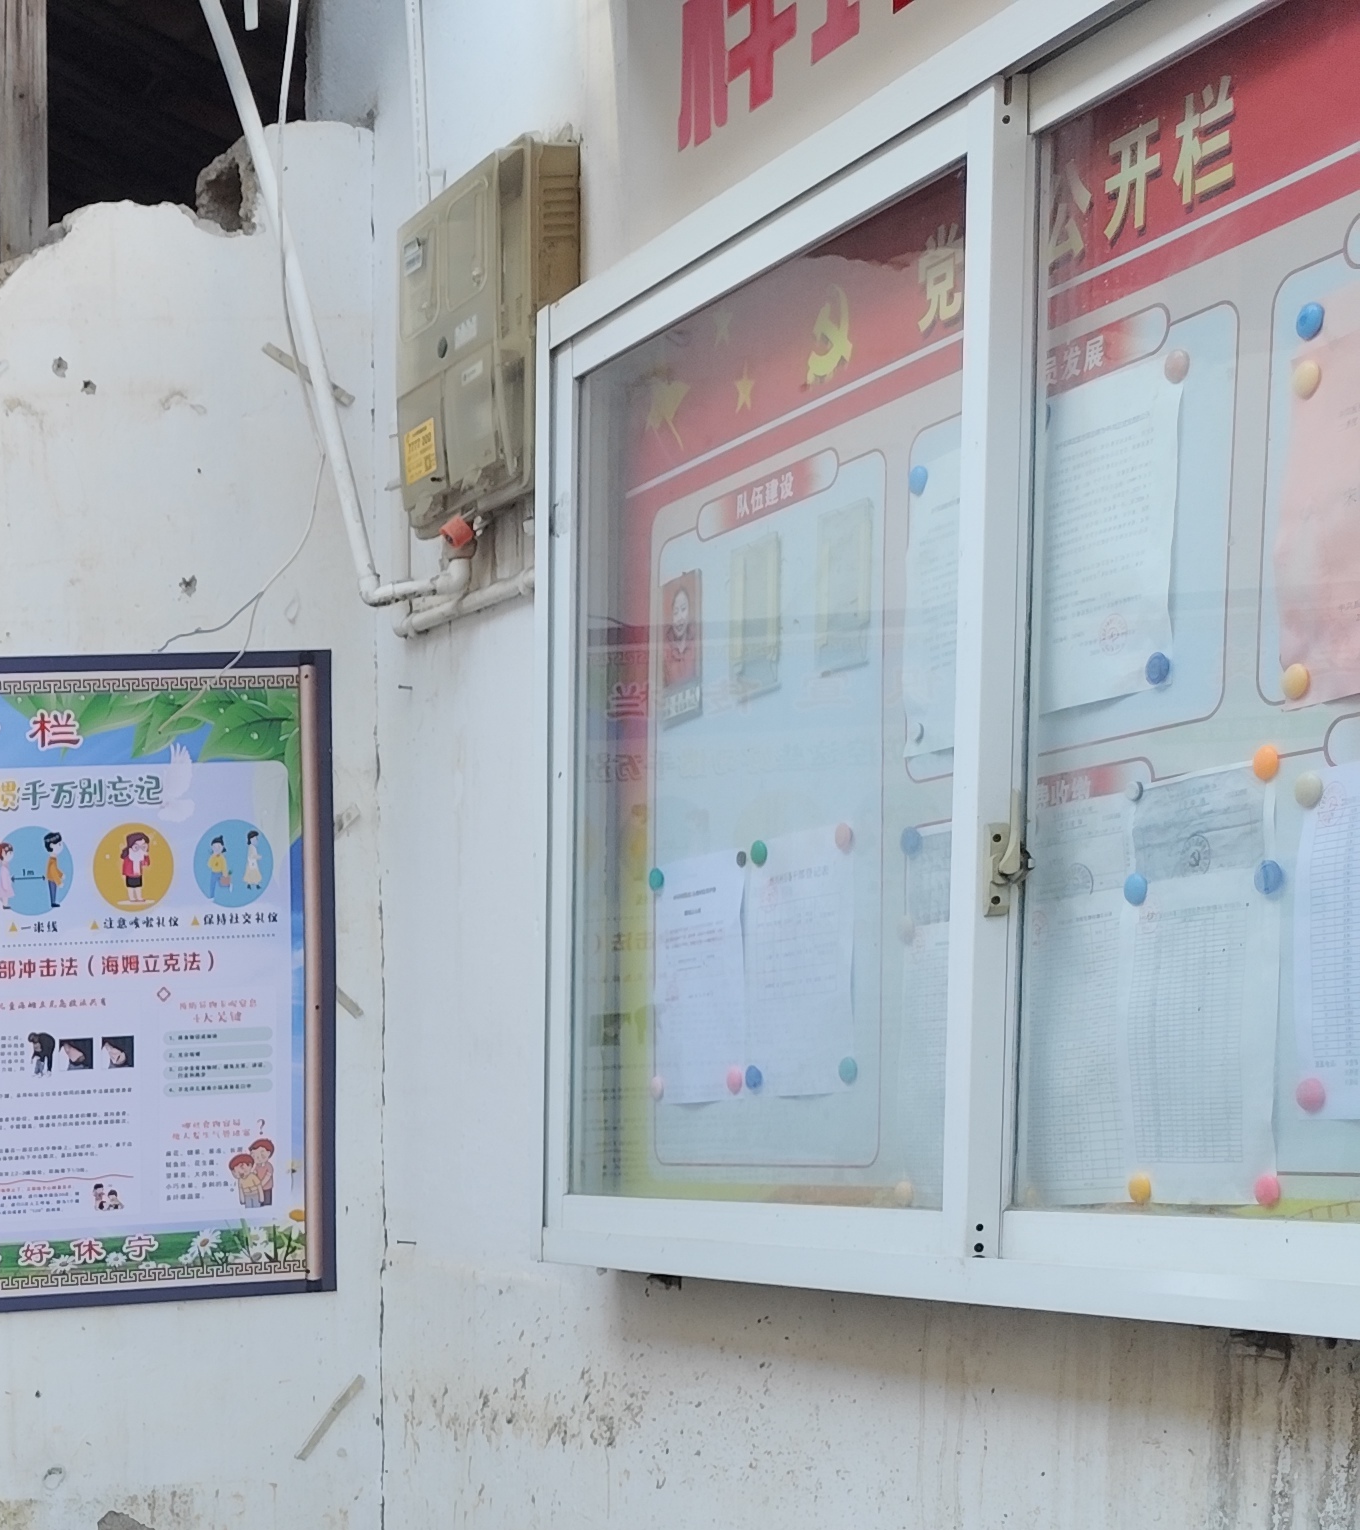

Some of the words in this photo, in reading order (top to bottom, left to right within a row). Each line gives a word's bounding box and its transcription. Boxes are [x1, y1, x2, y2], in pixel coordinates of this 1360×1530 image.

[1047, 75, 1237, 269] 公开栏
[734, 473, 795, 519] 队伍建设
[20, 919, 59, 934] 一米线
[103, 915, 180, 931] 注意咳嗽礼仪
[203, 911, 279, 926] 保持社交礼仪
